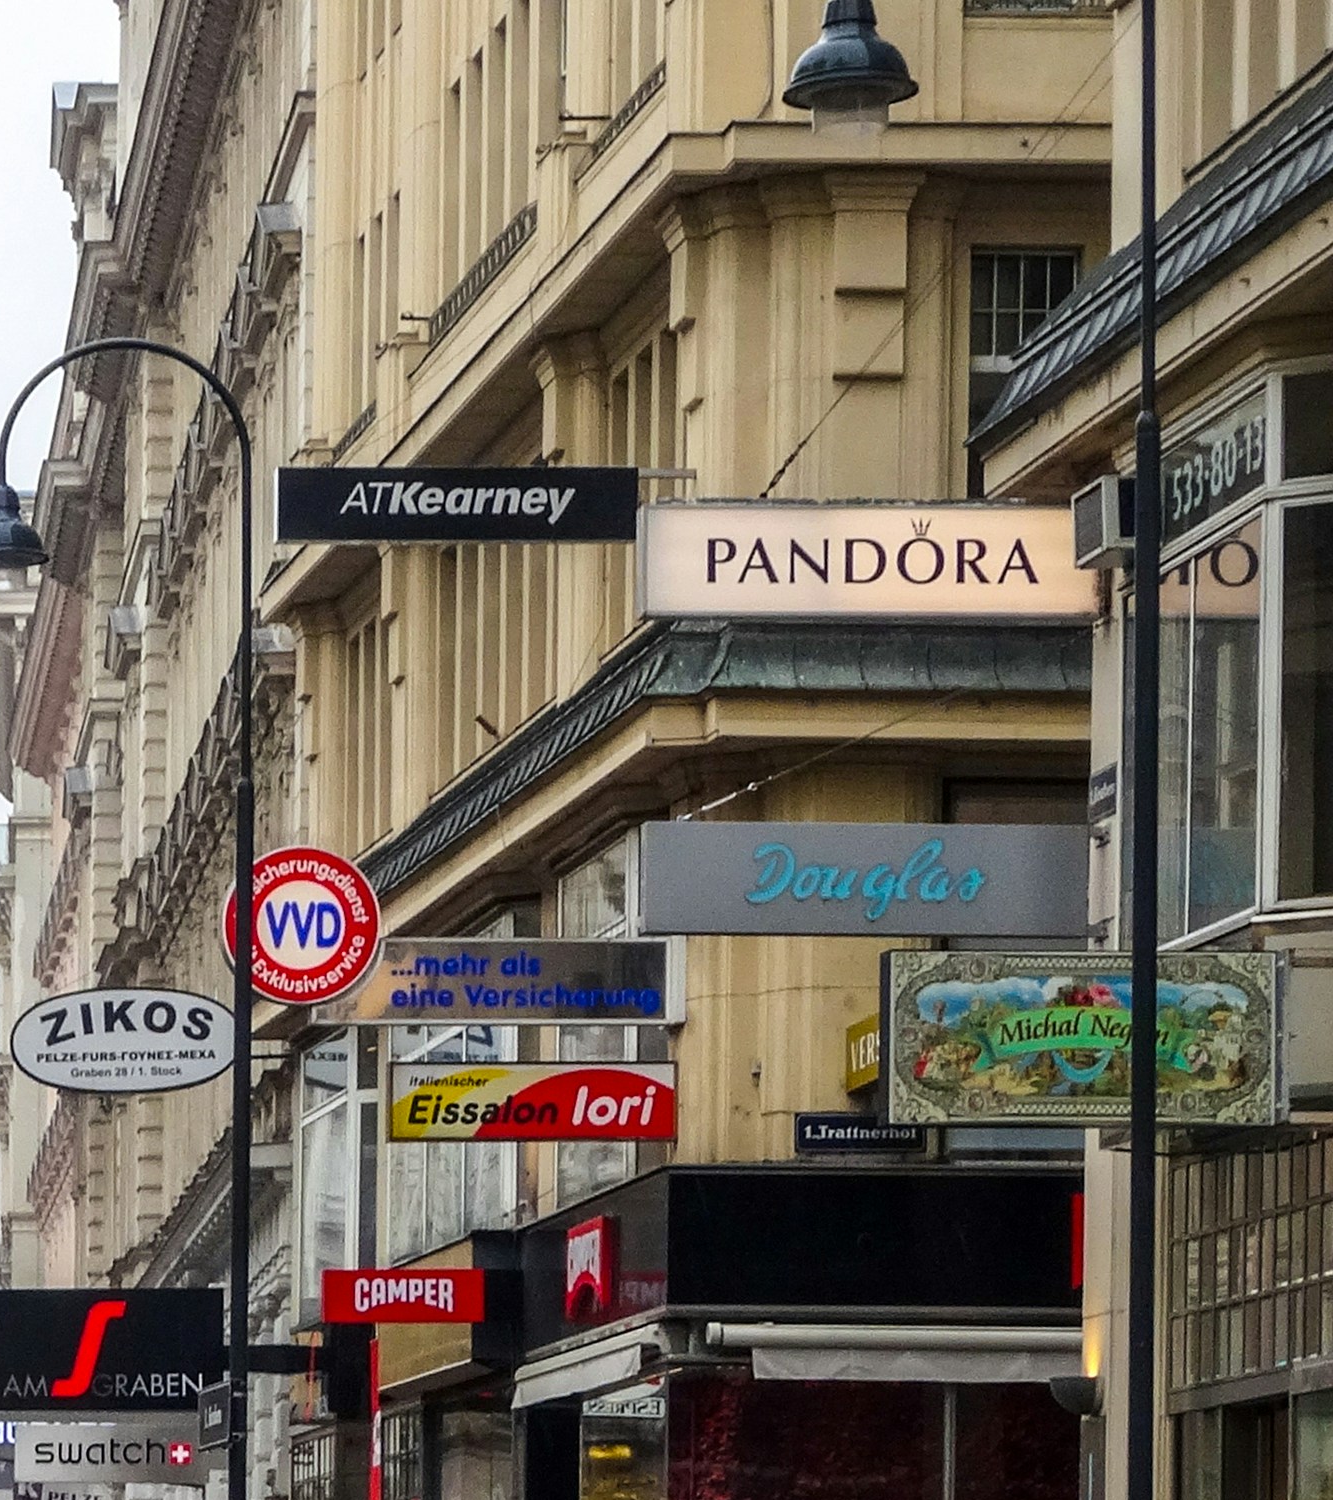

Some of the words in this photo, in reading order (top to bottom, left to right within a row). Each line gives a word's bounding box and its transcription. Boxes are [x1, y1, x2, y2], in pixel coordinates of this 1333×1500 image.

[706, 537, 1040, 585] PANDORA
[744, 837, 986, 922] Douglas
[265, 900, 342, 949] VVD
[500, 951, 541, 977] als
[391, 983, 455, 1008] eine
[463, 983, 661, 1016] Versicherung
[39, 999, 214, 1047] ZIKOS
[999, 1009, 1085, 1047] Michal
[1088, 1013, 1170, 1049] Negn
[70, 1065, 112, 1078] Graben
[150, 1065, 183, 1077] Stock
[409, 1075, 489, 1088] italienischer
[408, 1094, 559, 1126] Eissalon
[571, 1085, 657, 1127] lori
[354, 1277, 454, 1313] CAMPER
[3, 1374, 49, 1397] AM
[92, 1372, 204, 1397] GRABEN
[35, 1438, 166, 1465] swatch
